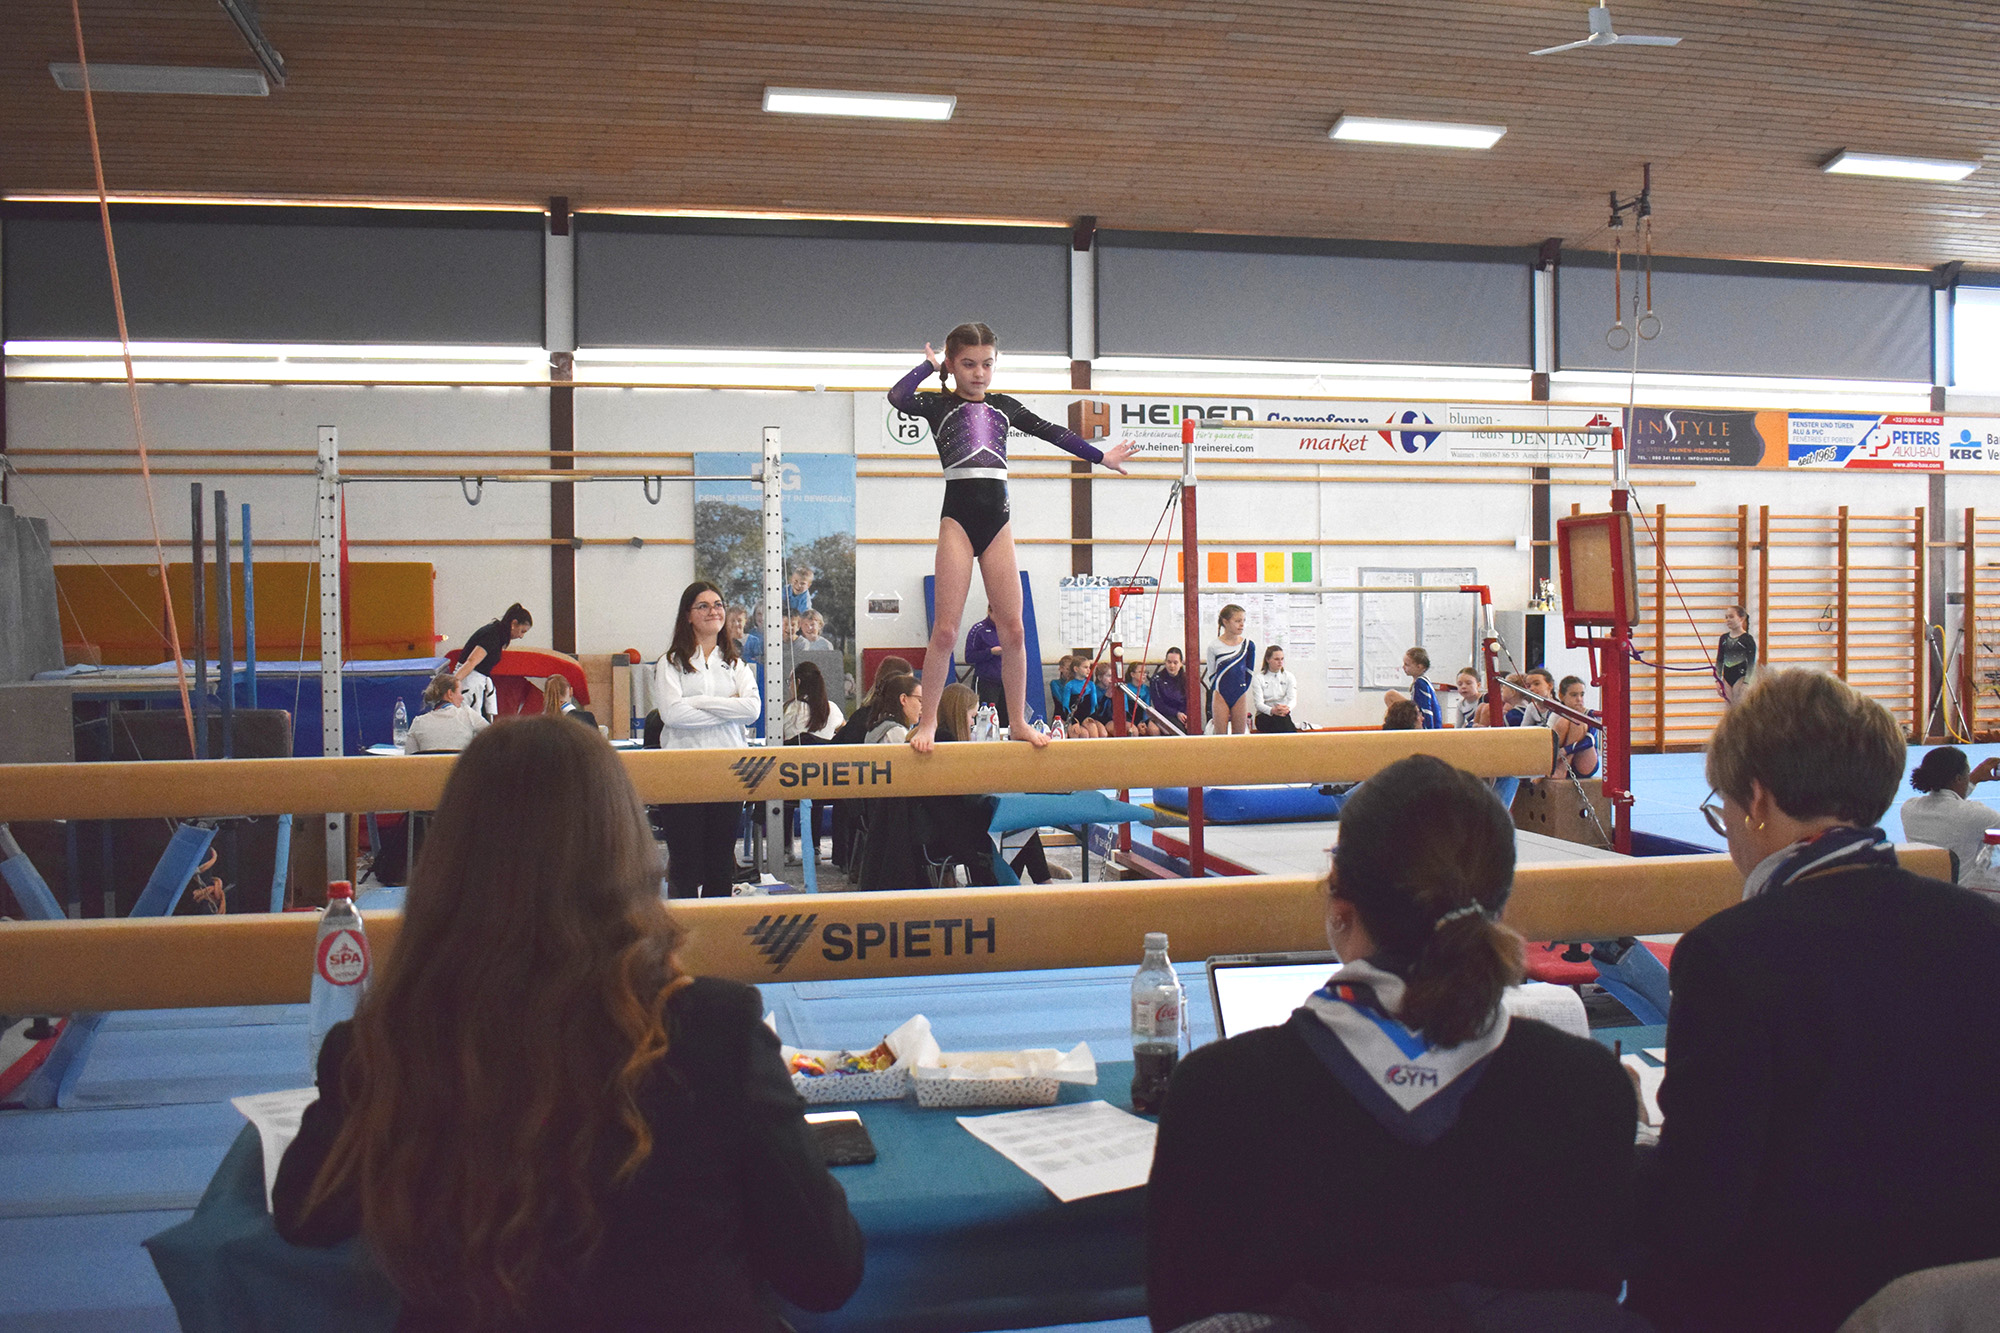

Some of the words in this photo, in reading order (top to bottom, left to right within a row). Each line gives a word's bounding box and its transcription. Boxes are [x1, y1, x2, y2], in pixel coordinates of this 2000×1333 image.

[1450, 412, 1493, 424] blumen
[899, 424, 920, 438] ra
[1638, 409, 1730, 443] INSTYLE
[1299, 433, 1368, 453] market
[1511, 432, 1546, 444] DEN
[1554, 433, 1607, 446] TANDT
[1892, 431, 1941, 445] PETERS
[1798, 454, 1814, 466] seit
[1815, 445, 1837, 462] 1965
[1892, 446, 1941, 458] ALKU-BAU
[1950, 449, 1983, 460] KBC
[1065, 576, 1109, 587] 2026
[779, 761, 892, 787] SPIETH
[822, 917, 996, 962] SPIETH
[329, 953, 361, 965] SPA
[1386, 1065, 1438, 1087] GYM
